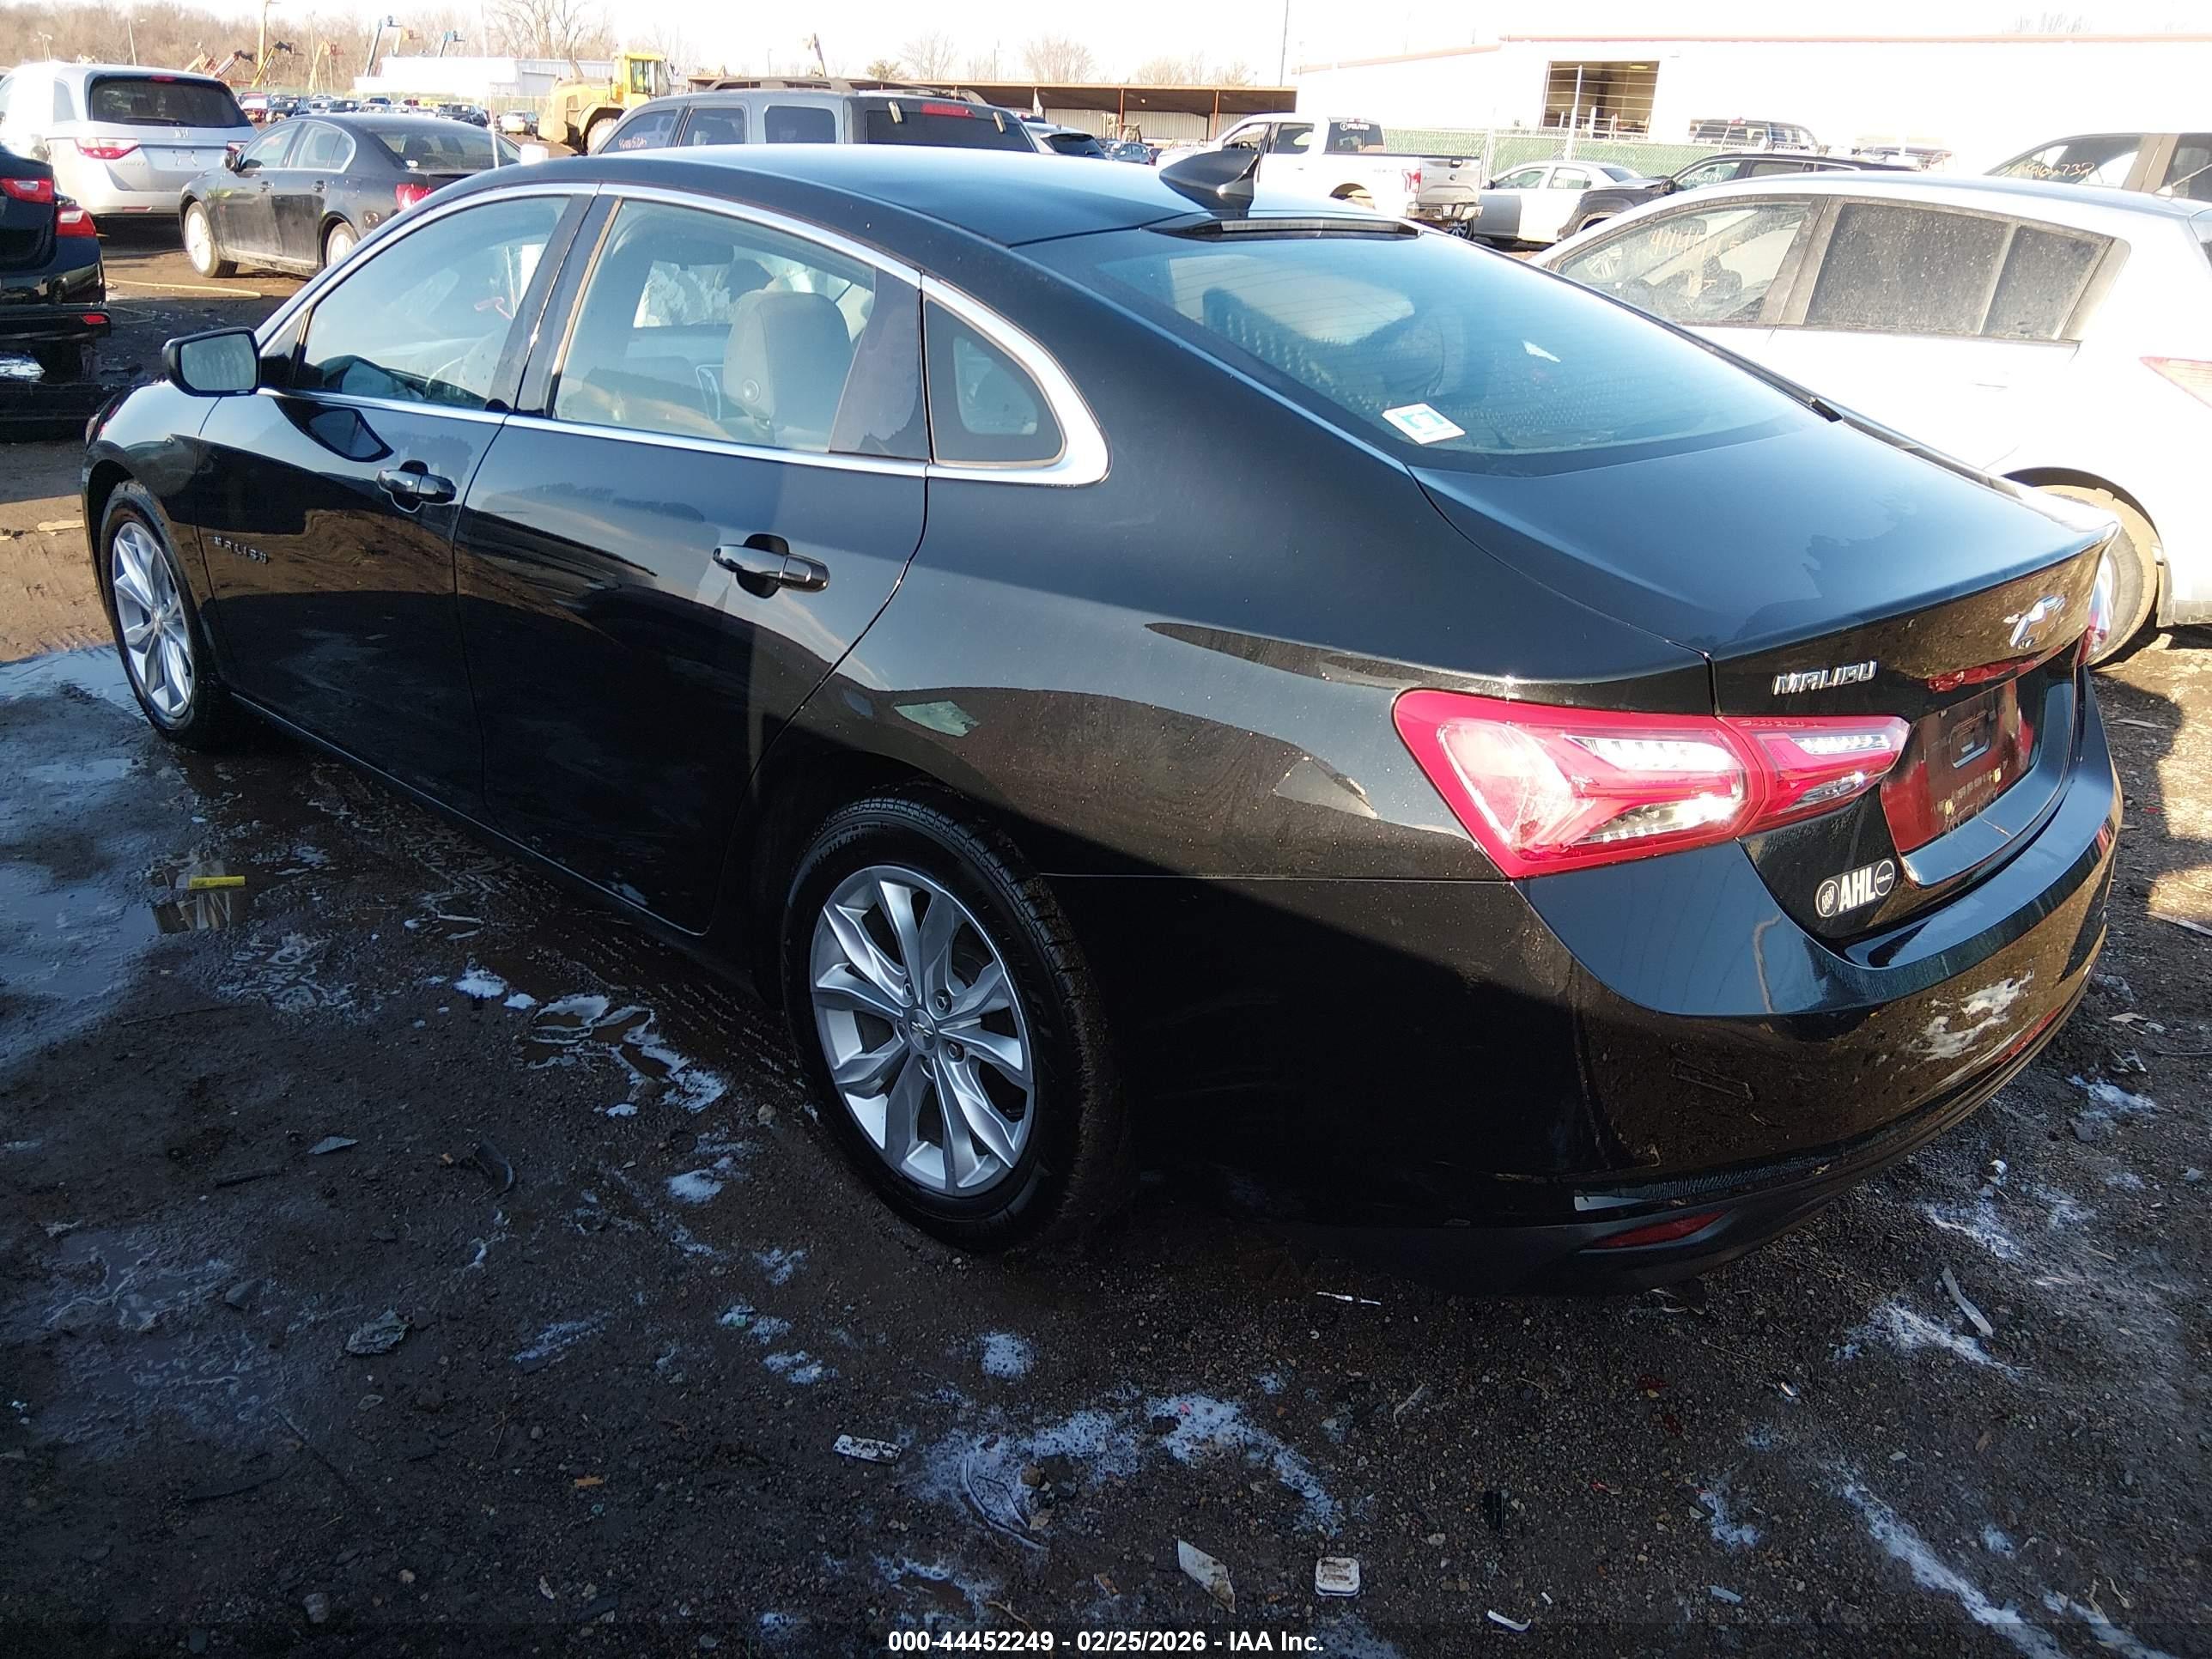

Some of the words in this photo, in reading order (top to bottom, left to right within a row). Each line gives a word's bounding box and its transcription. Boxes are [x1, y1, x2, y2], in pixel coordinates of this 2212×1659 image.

[1771, 660, 1878, 696] MALIBU
[1838, 866, 1876, 913] AHL
[1876, 872, 1893, 884] GMC
